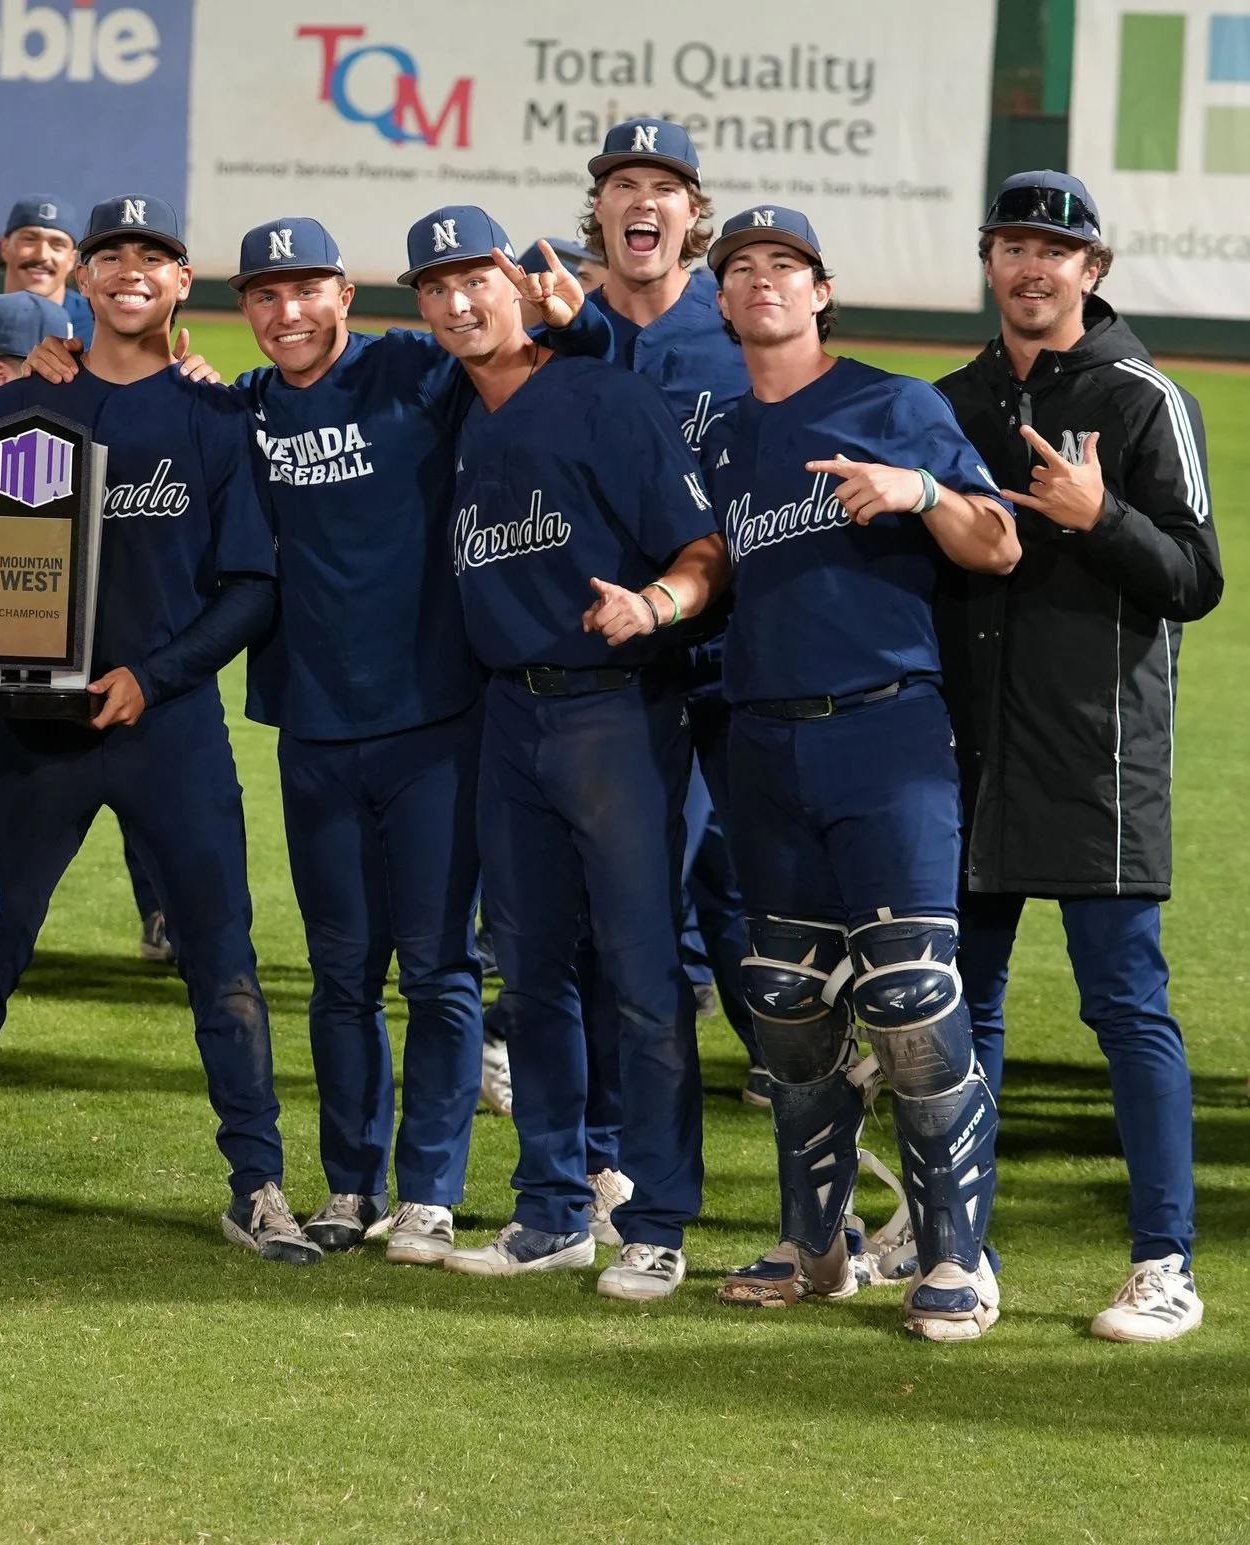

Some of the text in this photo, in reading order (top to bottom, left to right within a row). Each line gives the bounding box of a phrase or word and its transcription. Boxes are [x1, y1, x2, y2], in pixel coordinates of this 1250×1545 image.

[297, 24, 475, 150] TQM
[524, 38, 877, 106] Total Quality
[522, 99, 876, 157] Maienance
[630, 125, 658, 153] N
[121, 198, 148, 225] N
[268, 228, 296, 261] N
[432, 218, 462, 252] N
[256, 422, 367, 467] NEVADA
[453, 489, 572, 577] Nevada
[0, 555, 63, 570] MOUNTAIN
[0, 570, 62, 593] WEST
[948, 1102, 986, 1156] EASTON
